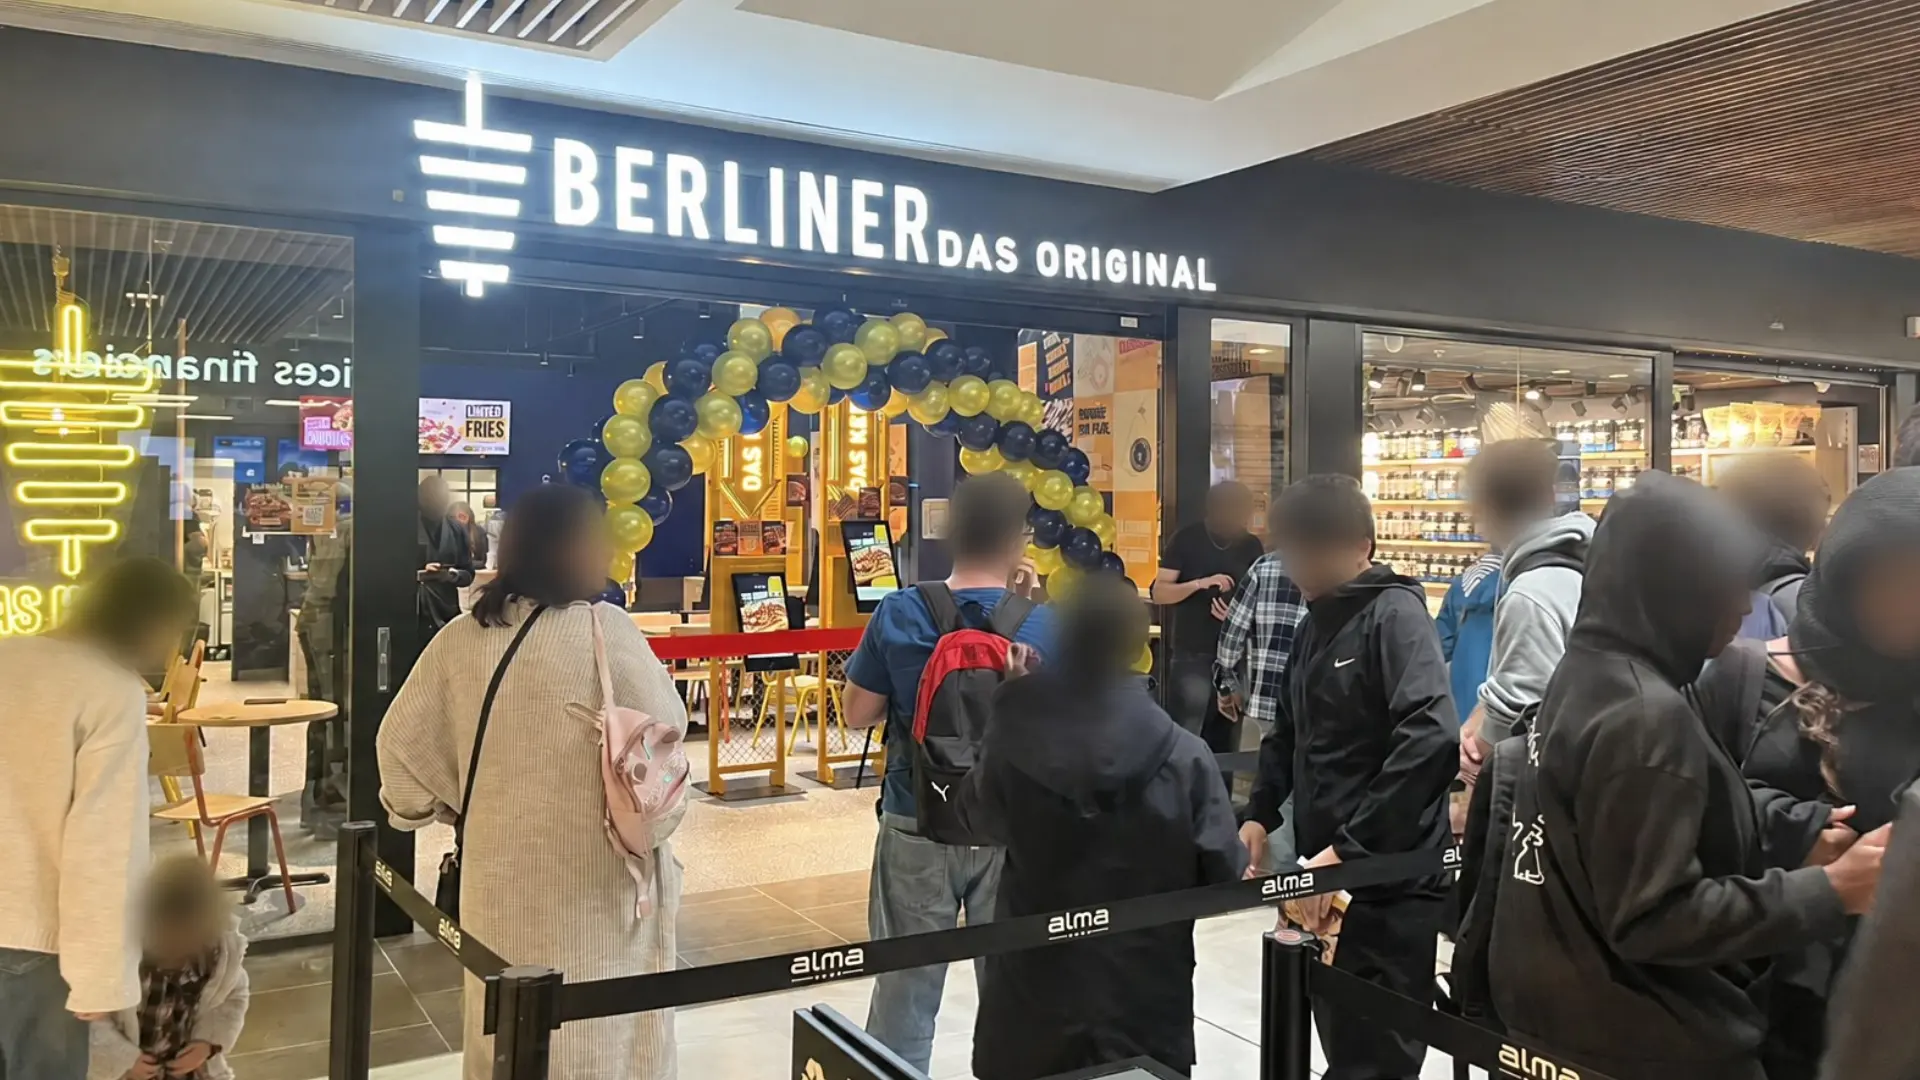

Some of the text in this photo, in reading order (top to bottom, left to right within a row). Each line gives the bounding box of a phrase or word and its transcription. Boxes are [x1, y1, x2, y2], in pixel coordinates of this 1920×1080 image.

[553, 137, 1217, 292] BERLINER DAS ORIGINAL
[466, 420, 504, 438] FRIES
[742, 446, 763, 491] DAS
[1262, 872, 1314, 895] alma
[1047, 908, 1109, 934] alma
[791, 947, 864, 975] alma
